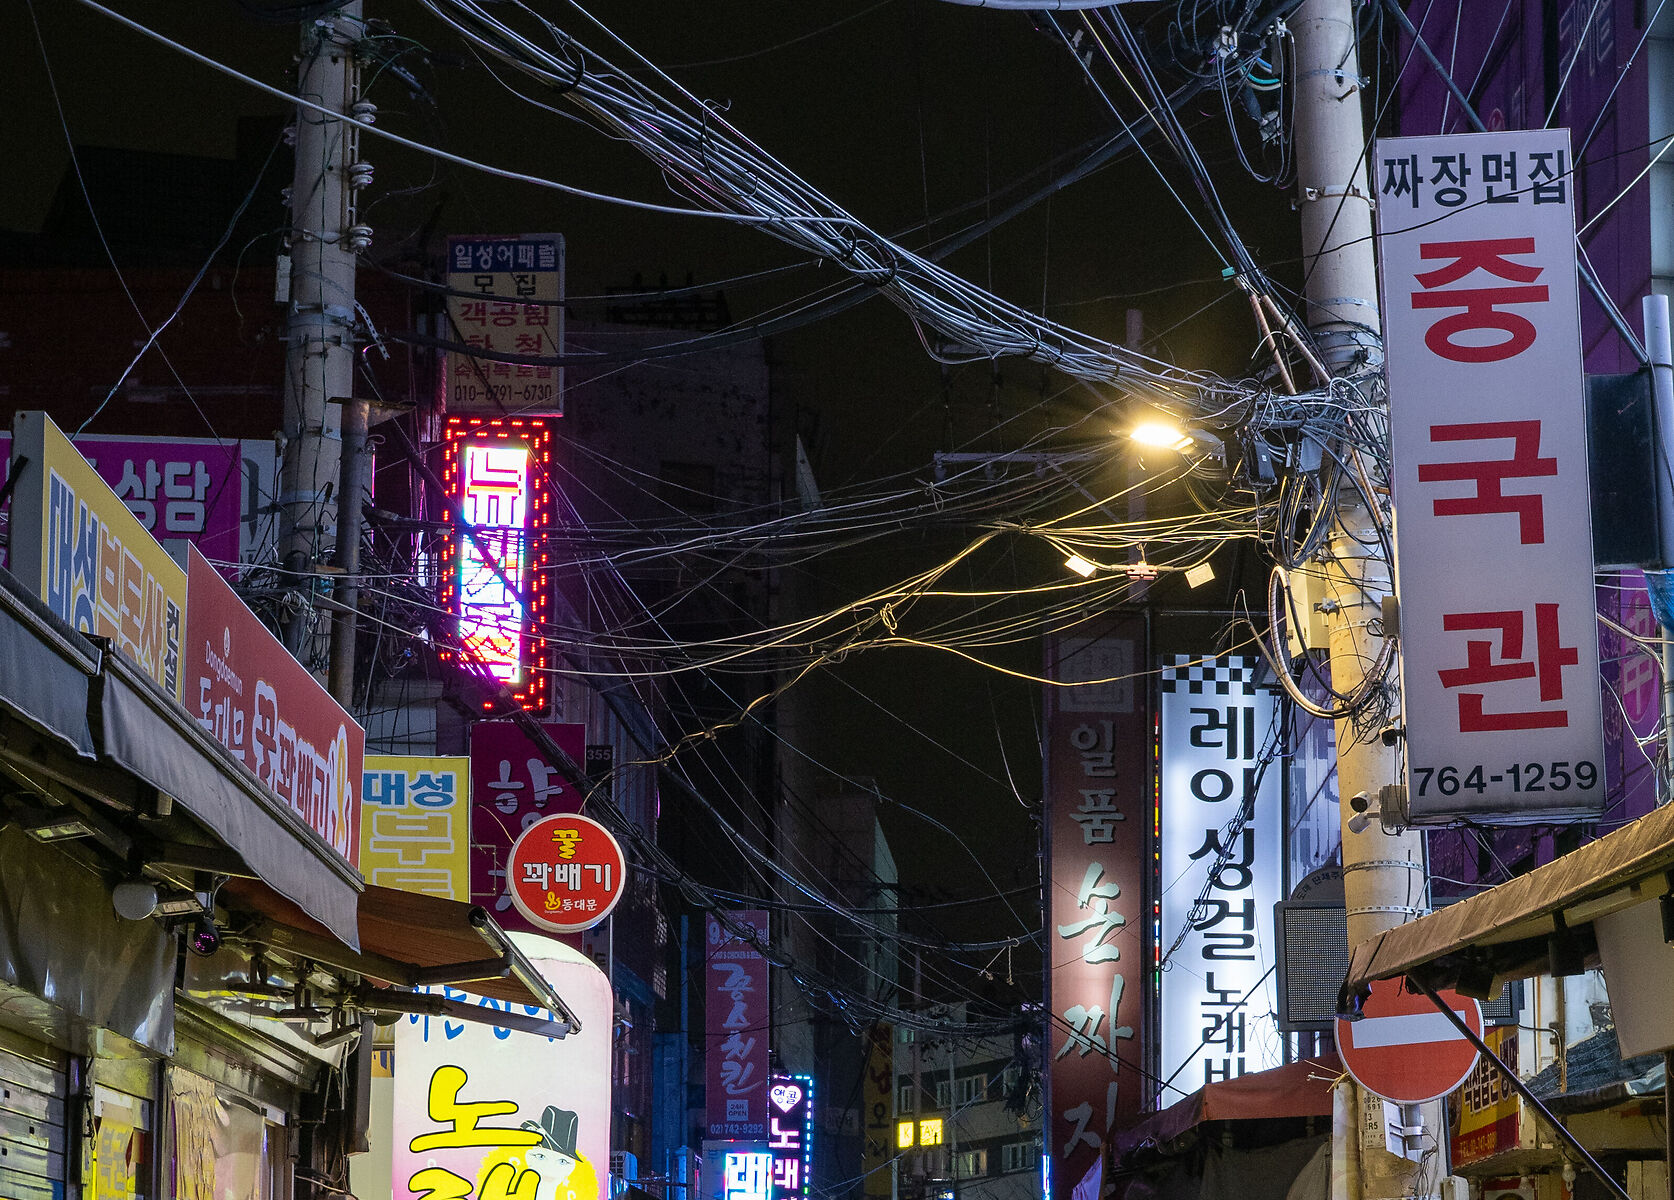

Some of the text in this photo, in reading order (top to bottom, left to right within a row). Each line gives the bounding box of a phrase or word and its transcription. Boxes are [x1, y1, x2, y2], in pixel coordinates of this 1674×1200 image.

[1382, 149, 1568, 210] 짜장면집
[455, 244, 555, 269] 일성어패럴
[474, 274, 537, 296] 모집
[1410, 236, 1579, 734] 중국관
[586, 749, 612, 761] 355
[363, 773, 455, 808] 대성
[1412, 760, 1599, 798] 764-1259
[551, 829, 583, 860] 꿀
[522, 862, 612, 892] 꽈배기
[562, 898, 598, 912] 동대문
